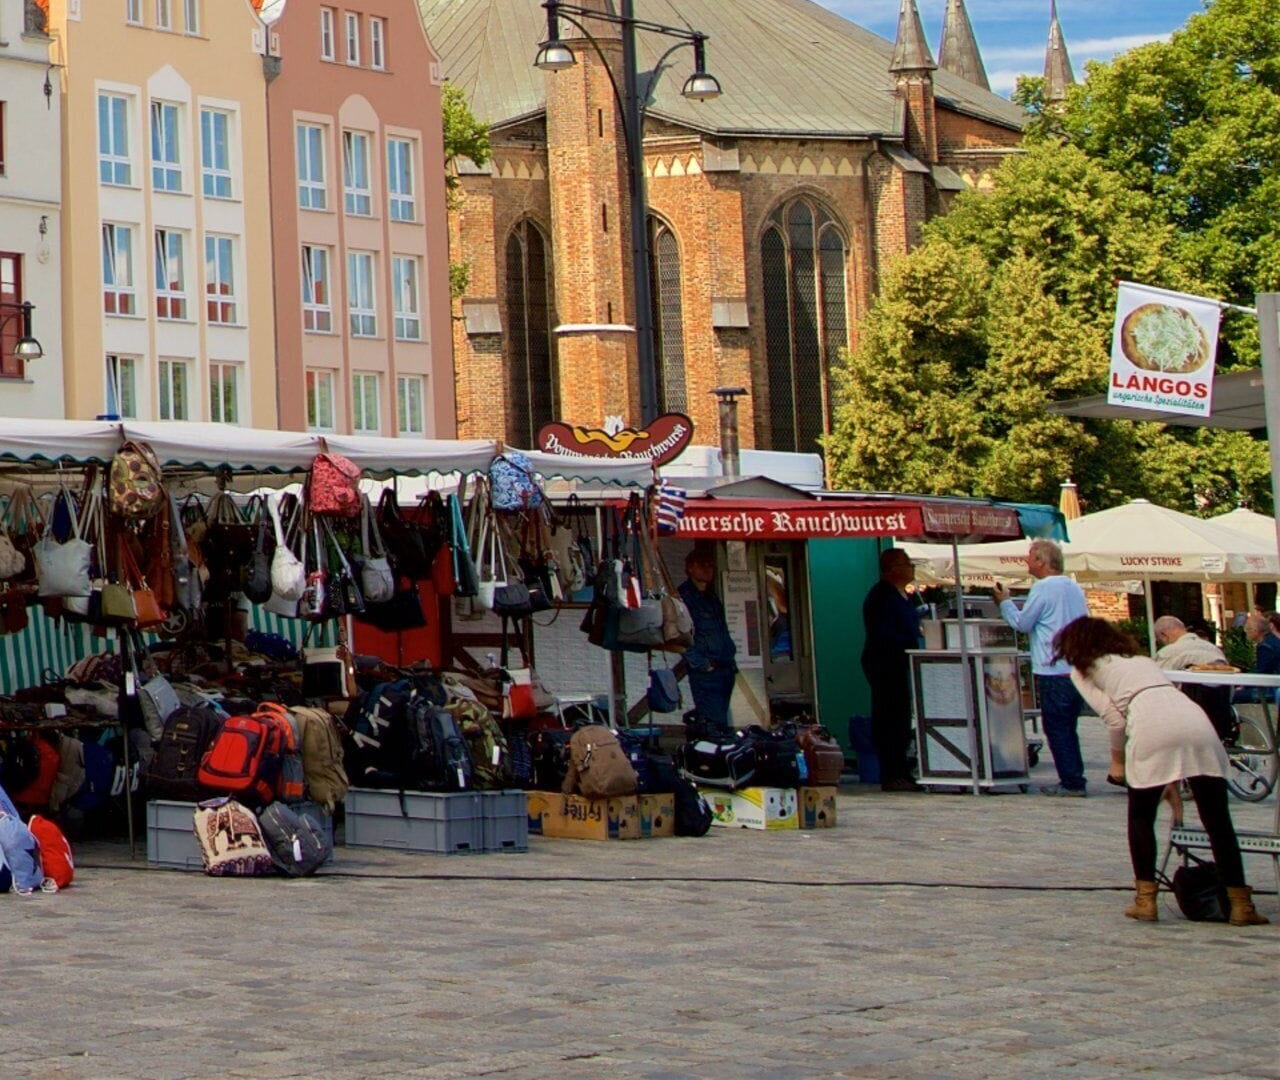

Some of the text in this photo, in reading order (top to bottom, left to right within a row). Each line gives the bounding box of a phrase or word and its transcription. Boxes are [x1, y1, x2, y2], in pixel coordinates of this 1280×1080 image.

[772, 511, 907, 536] Rauchwurst
[1120, 557, 1183, 566] LUCKY STRIKE
